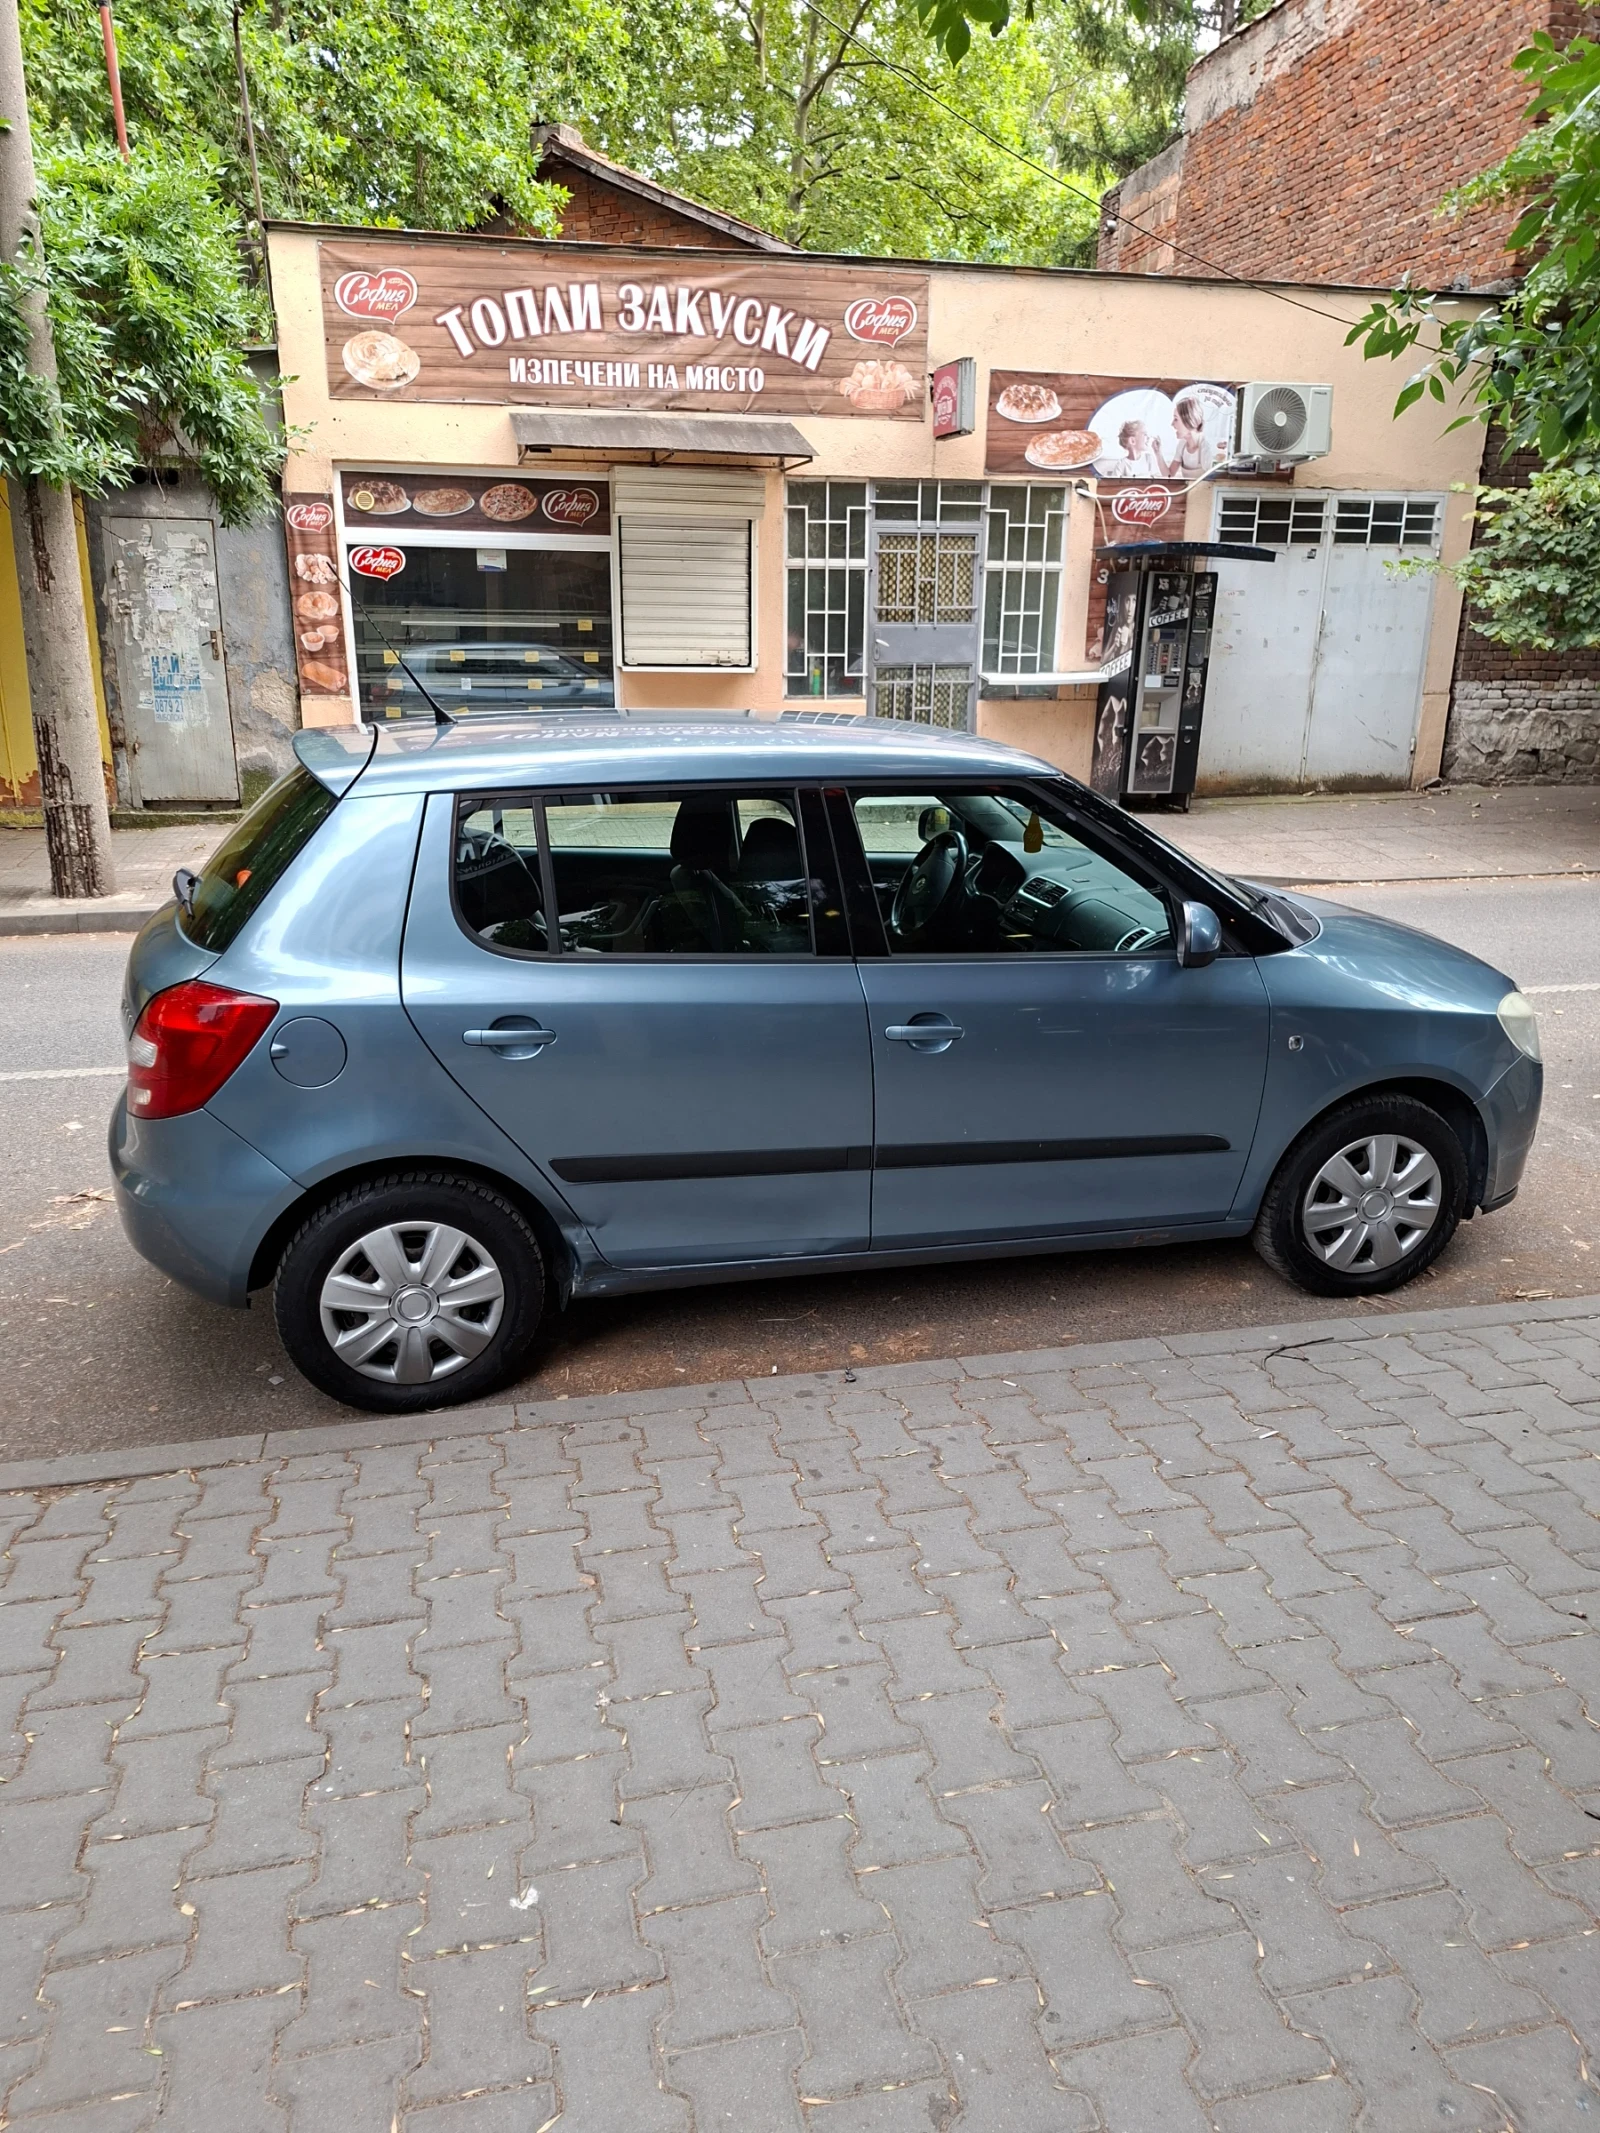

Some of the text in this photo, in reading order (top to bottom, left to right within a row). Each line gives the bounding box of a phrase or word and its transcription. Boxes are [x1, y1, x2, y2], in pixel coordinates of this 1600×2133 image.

[343, 275, 408, 311] София
[375, 302, 399, 311] МЕЛ
[851, 302, 909, 336] София
[435, 283, 831, 372] ТОПЛИ ЗАКУСКИ
[878, 327, 899, 336] МЕЛ
[508, 357, 765, 393] ИЗПЕЧЕНИ НА МЯСТО
[548, 492, 592, 518] София
[1117, 486, 1164, 518] София
[291, 506, 328, 528] София
[354, 547, 399, 572] София
[375, 566, 392, 574] МЕЛ
[1150, 610, 1187, 627] COFFEE
